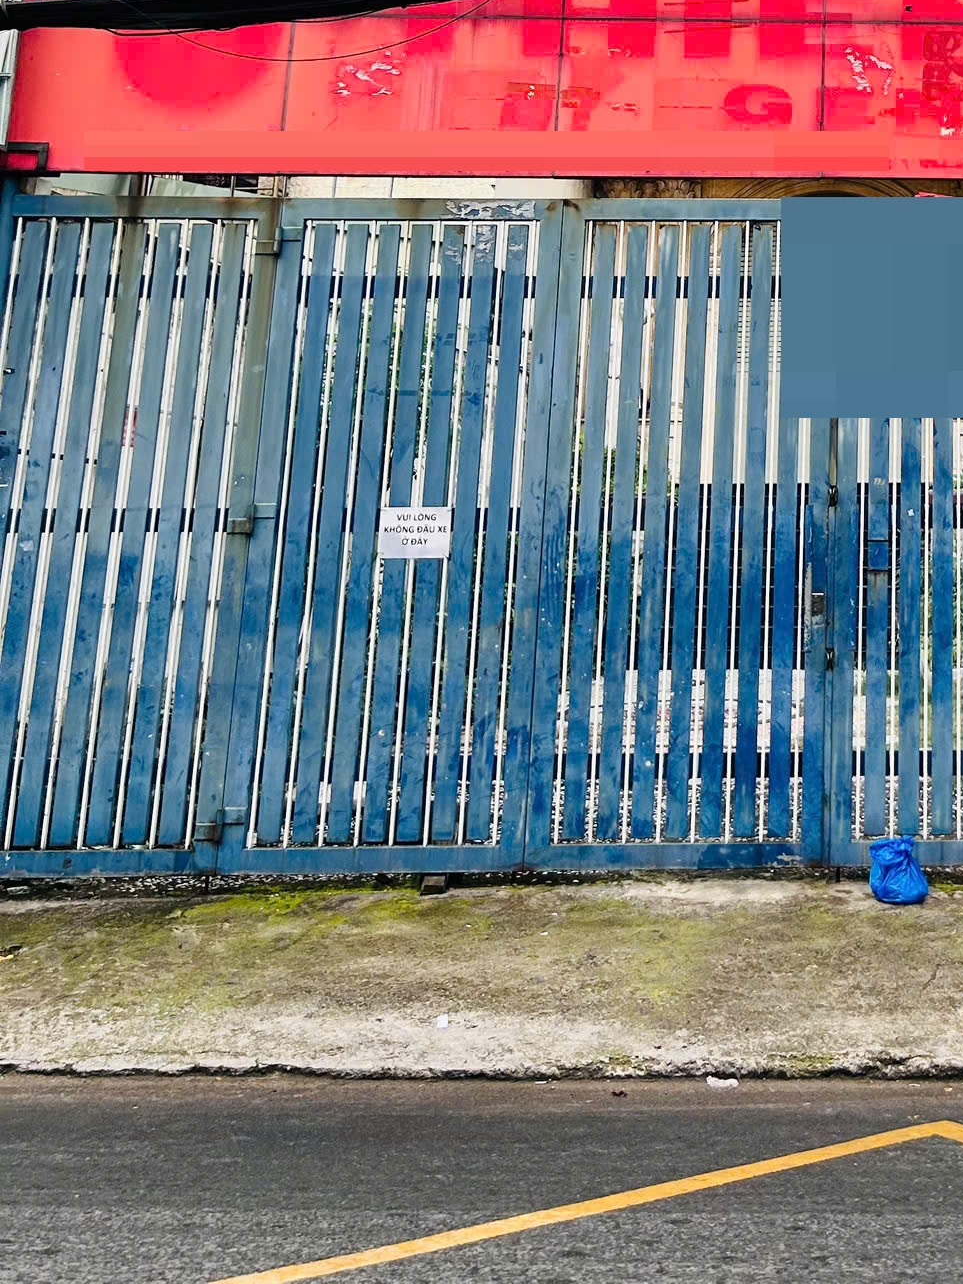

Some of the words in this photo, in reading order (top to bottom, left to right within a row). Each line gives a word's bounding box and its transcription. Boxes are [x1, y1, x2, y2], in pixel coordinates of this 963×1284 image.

[396, 513, 411, 522] VUI
[413, 512, 437, 522] LÒNG
[384, 525, 415, 534] KHÔNG
[437, 526, 448, 534] XE
[410, 537, 429, 546] ĐÂY
